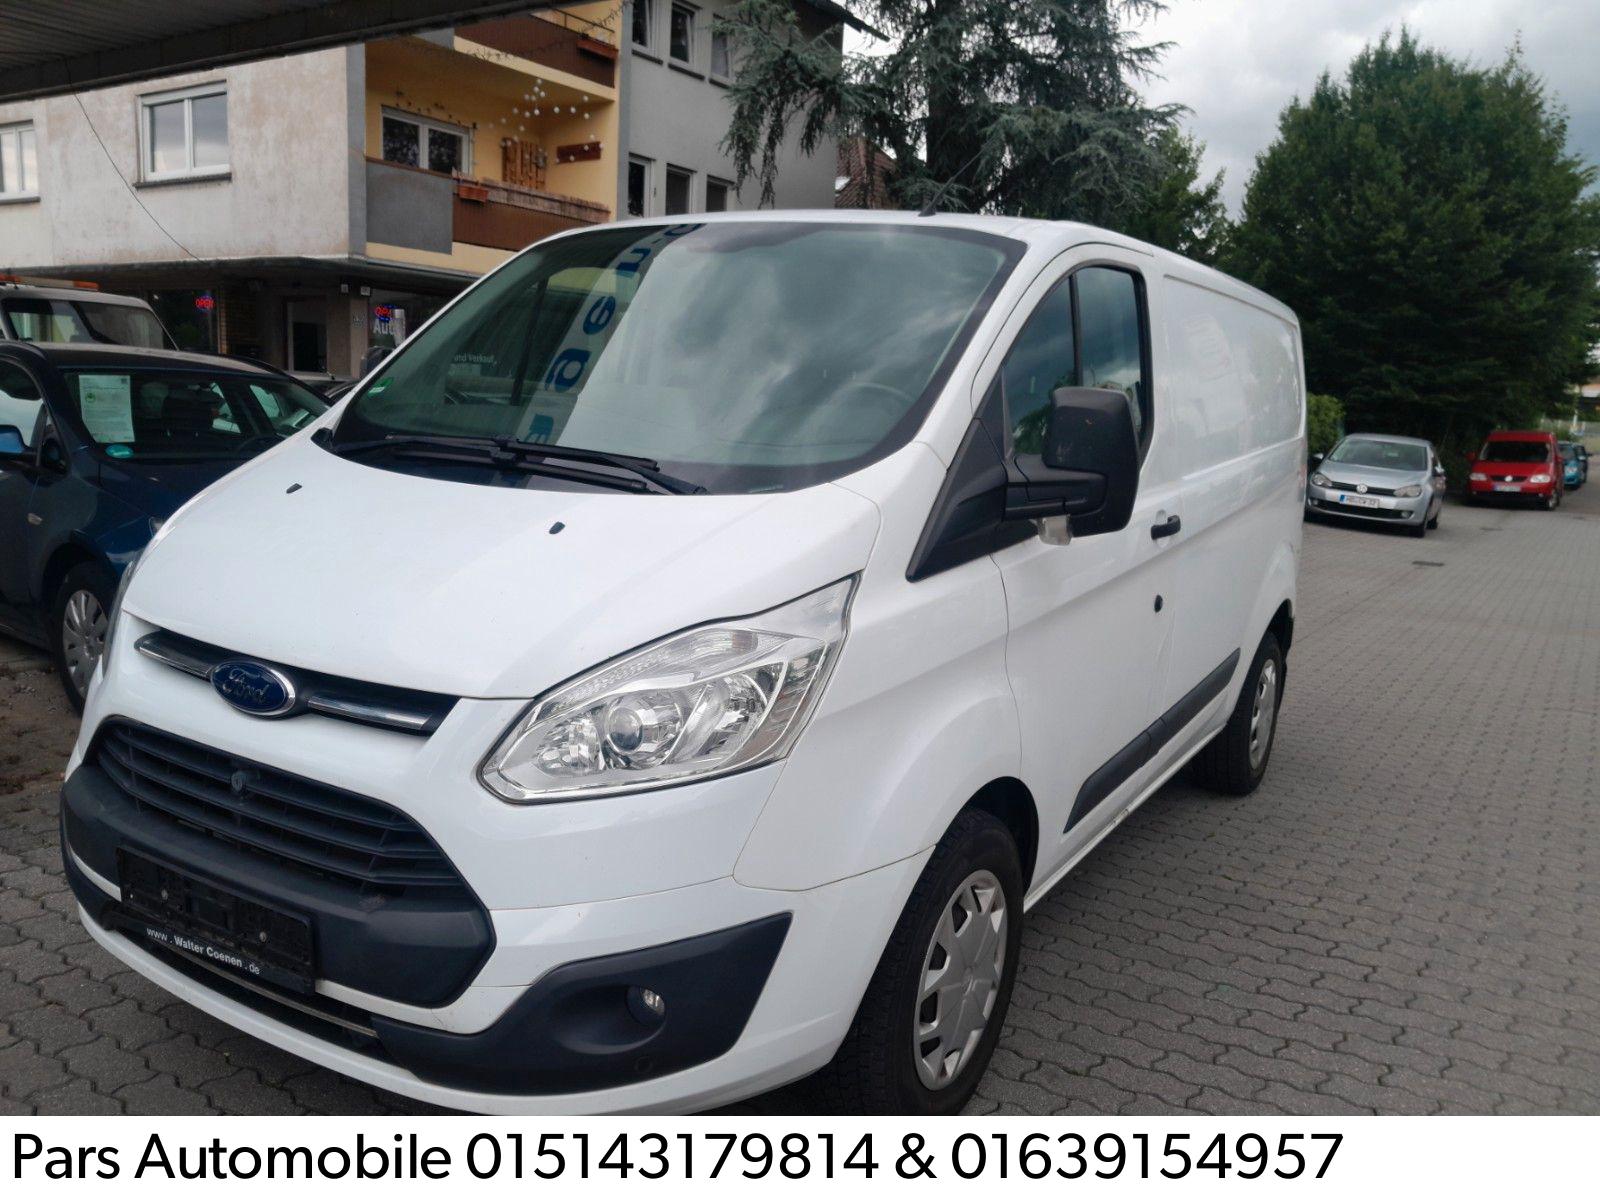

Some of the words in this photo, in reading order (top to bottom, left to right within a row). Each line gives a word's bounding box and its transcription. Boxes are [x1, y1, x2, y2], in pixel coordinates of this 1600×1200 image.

[222, 667, 270, 696] Ford
[173, 935, 205, 954] Walter
[206, 946, 243, 967] Coenen
